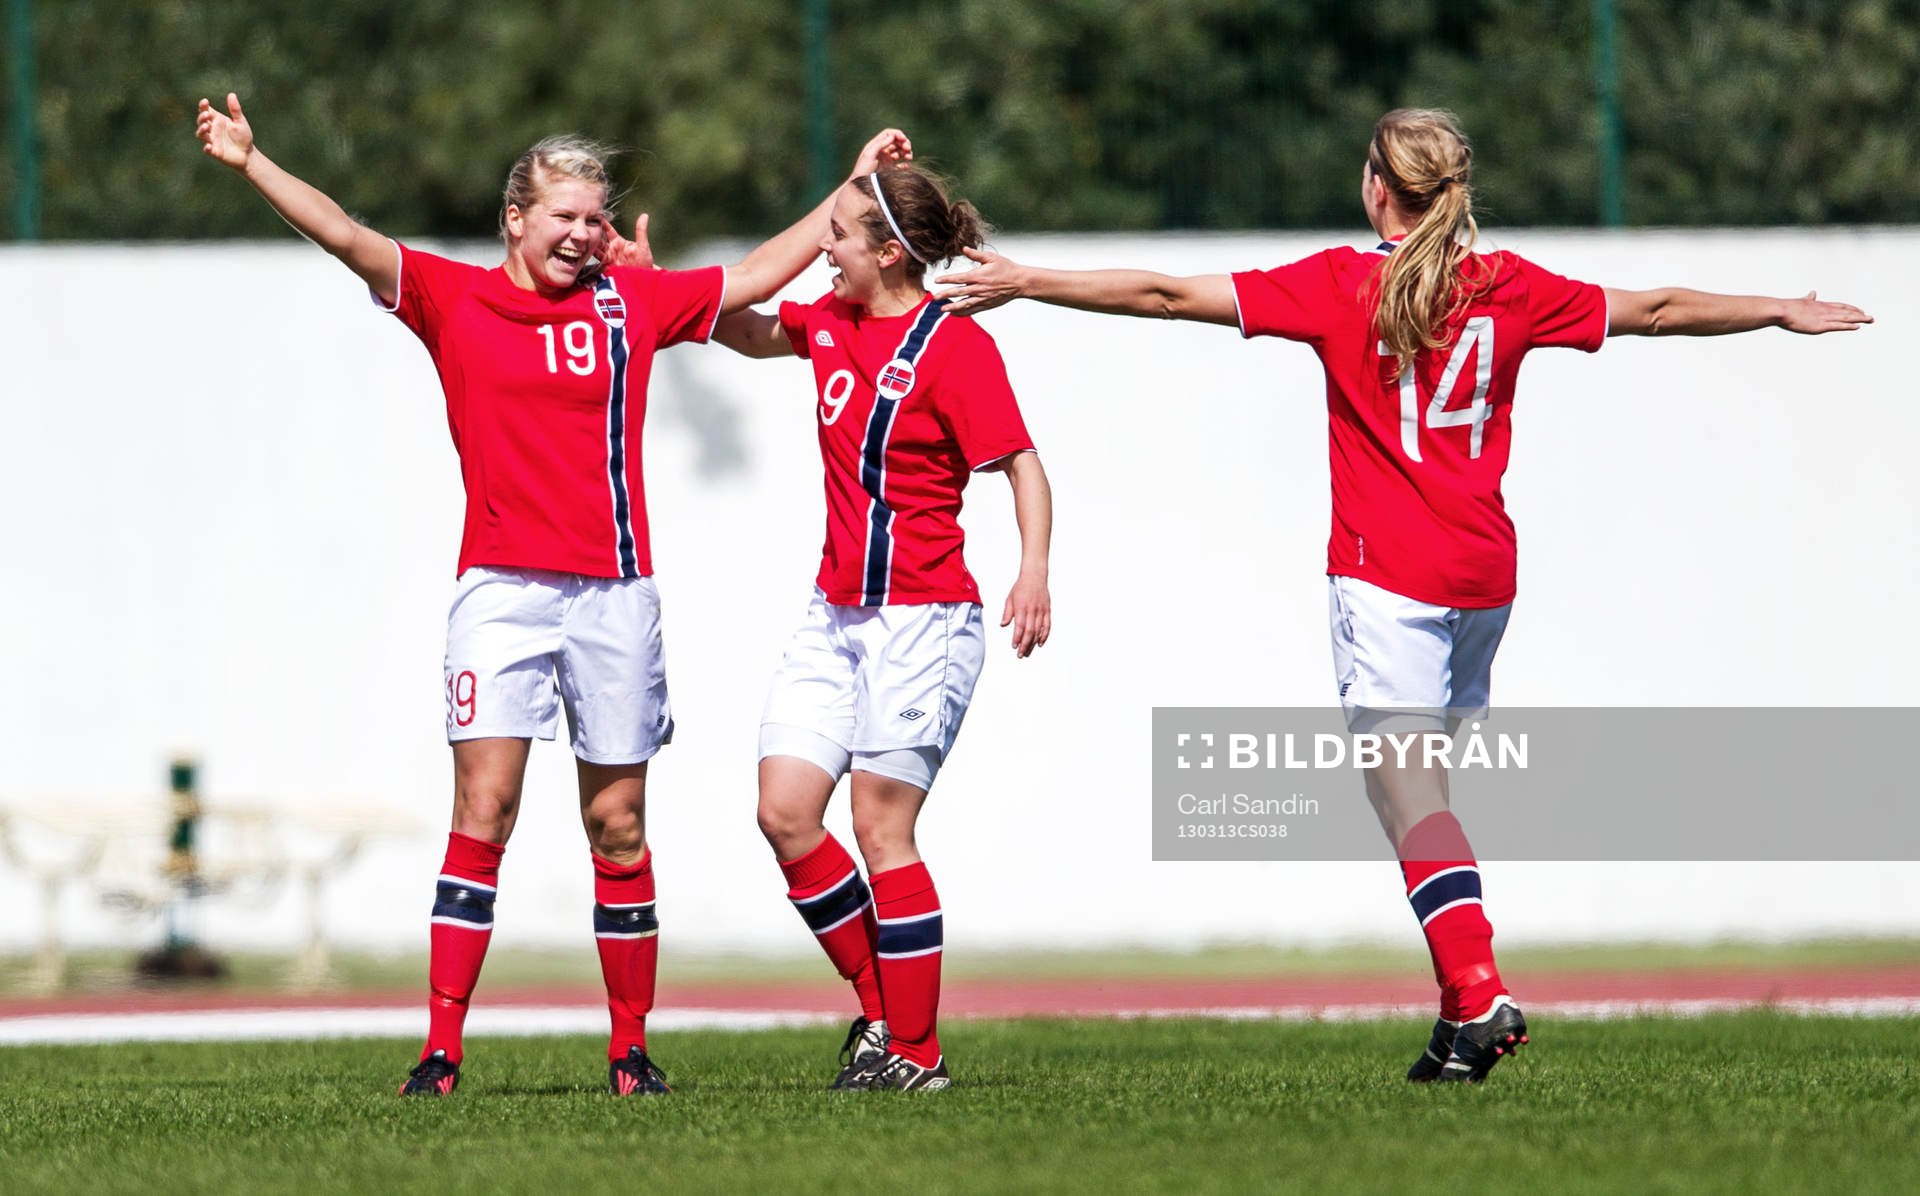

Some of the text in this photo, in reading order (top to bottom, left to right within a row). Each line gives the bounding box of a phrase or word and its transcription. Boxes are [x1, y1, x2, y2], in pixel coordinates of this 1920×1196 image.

[536, 321, 596, 376] 19
[819, 368, 856, 426] 9
[1377, 315, 1495, 463] 14
